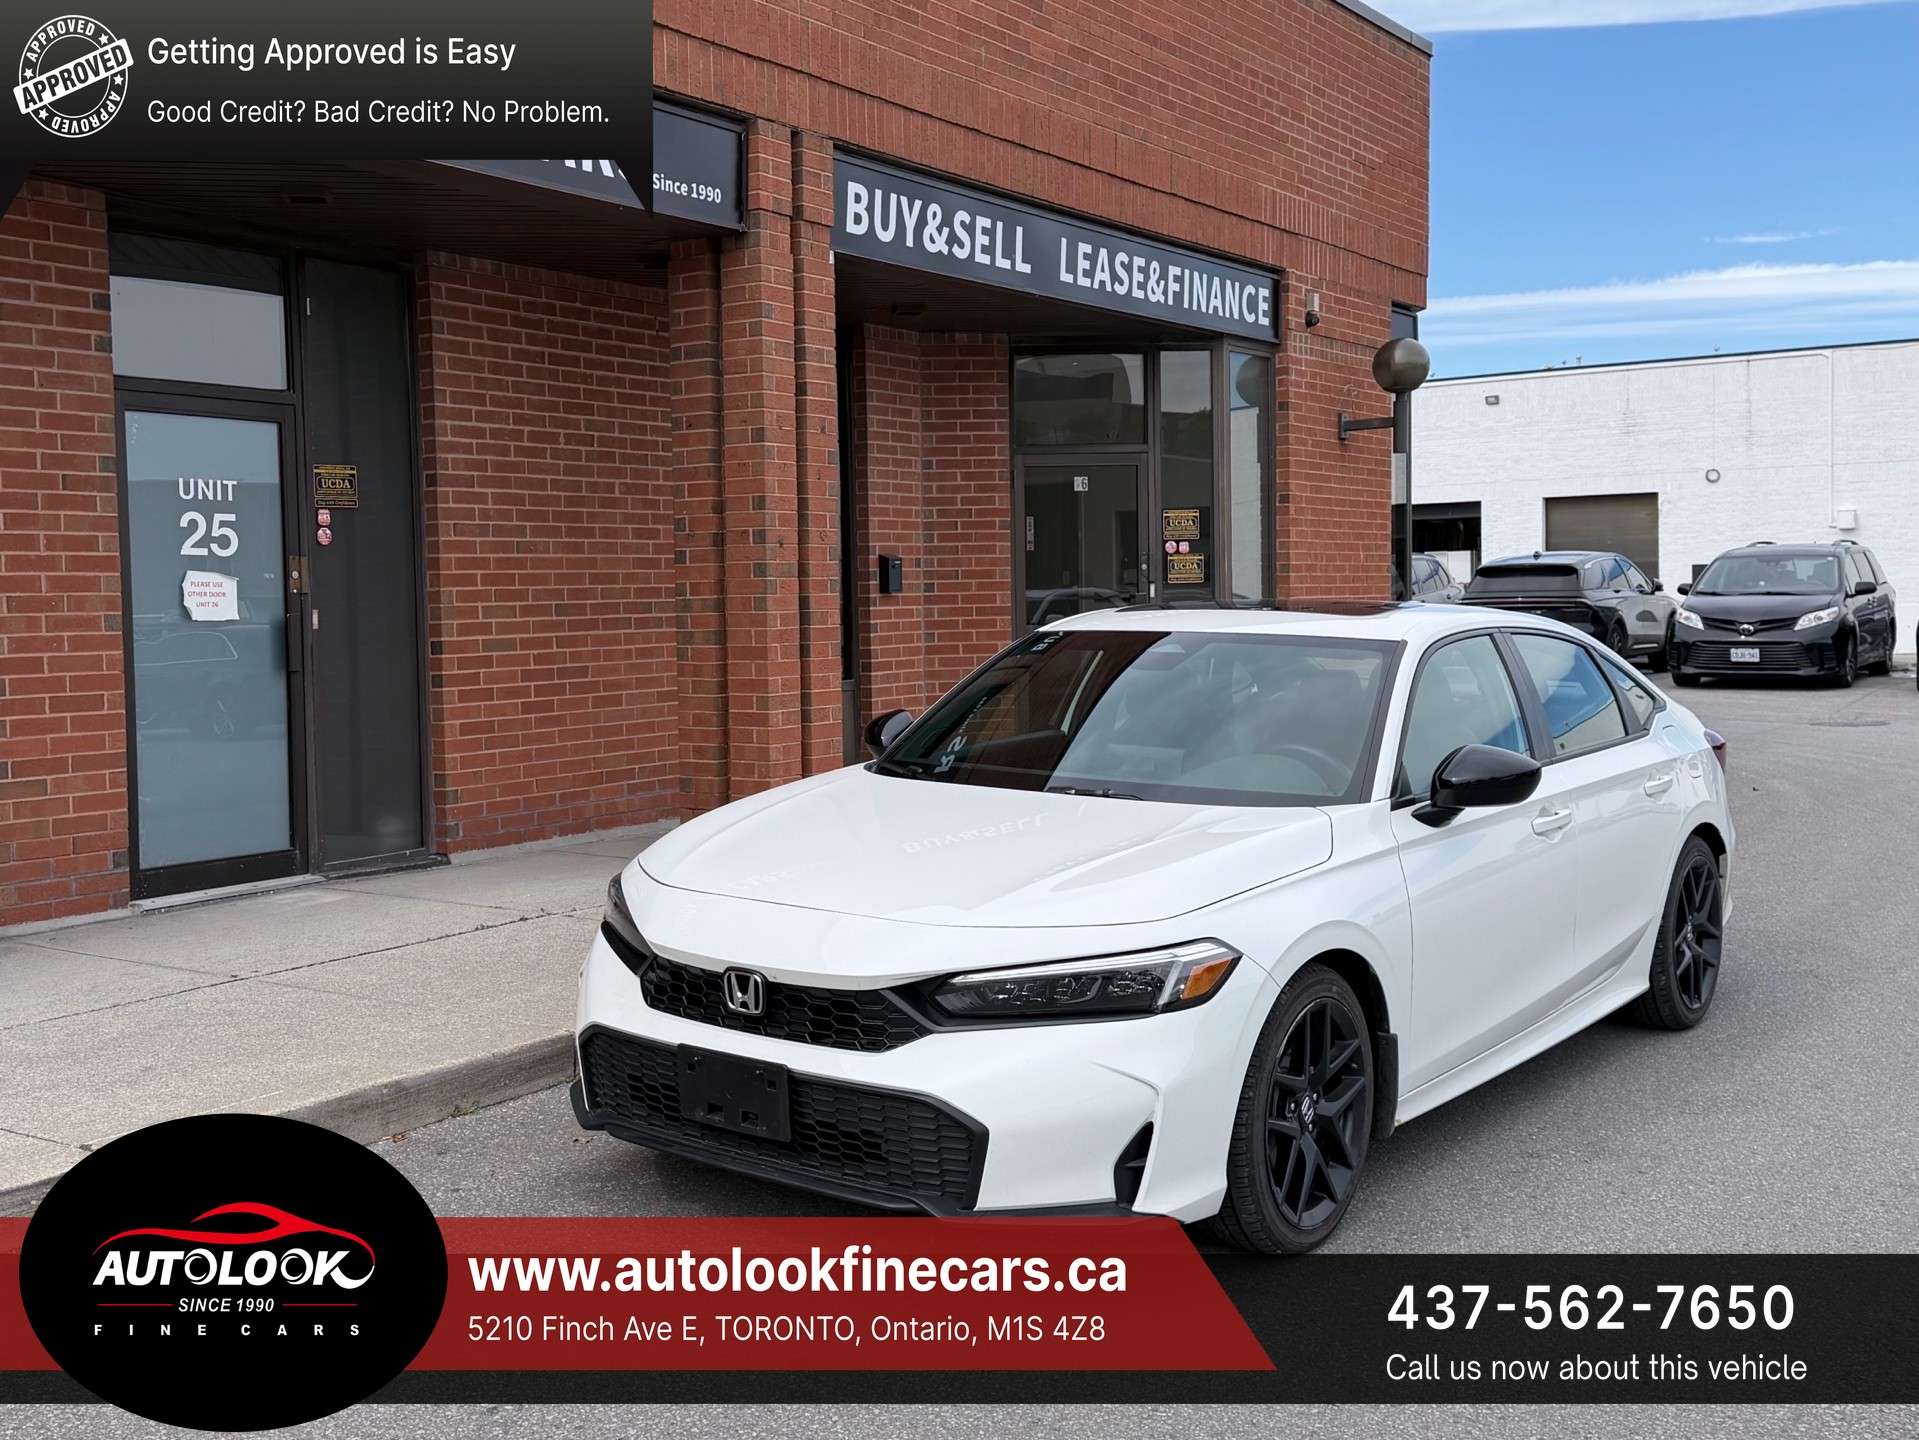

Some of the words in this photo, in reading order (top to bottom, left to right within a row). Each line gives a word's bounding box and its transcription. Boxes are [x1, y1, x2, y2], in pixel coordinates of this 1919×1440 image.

[652, 174, 688, 196] Since
[690, 182, 721, 204] 1990
[846, 181, 1031, 273] BUY&SELL
[1059, 237, 1270, 325] LEASE&FINANCE
[178, 478, 237, 501] UNIT
[321, 479, 351, 488] UCDA
[180, 512, 238, 557] 25
